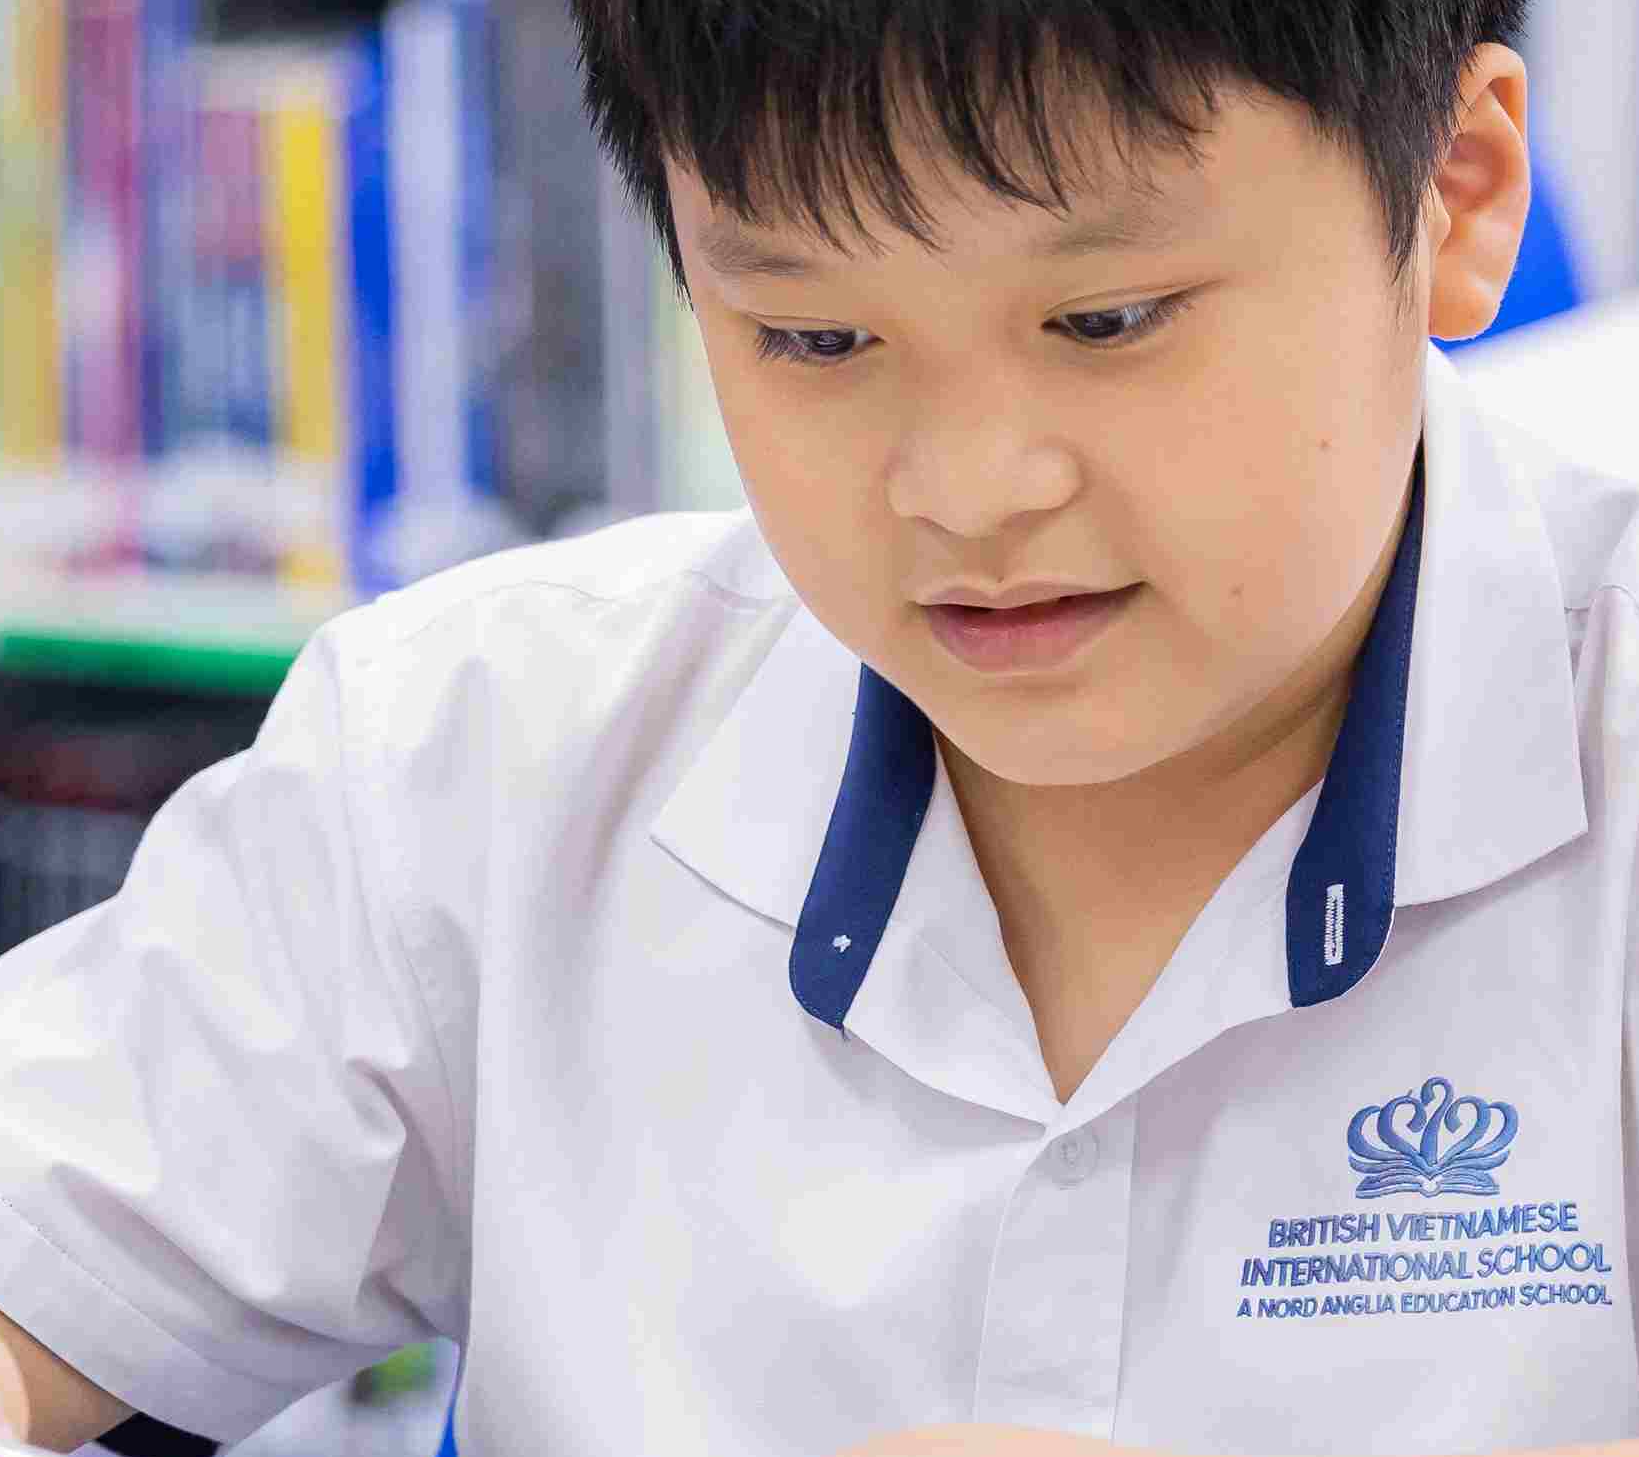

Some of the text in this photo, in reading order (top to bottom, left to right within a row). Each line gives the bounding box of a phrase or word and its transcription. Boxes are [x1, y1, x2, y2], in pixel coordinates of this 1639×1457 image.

[1267, 1201, 1579, 1248] BRITISH VIETNAMESE
[1240, 1242, 1613, 1287] INTERNATIONAL SCHOOL
[1236, 1284, 1613, 1318] A NORD ANGLIA EDUCATION SCHOOL
